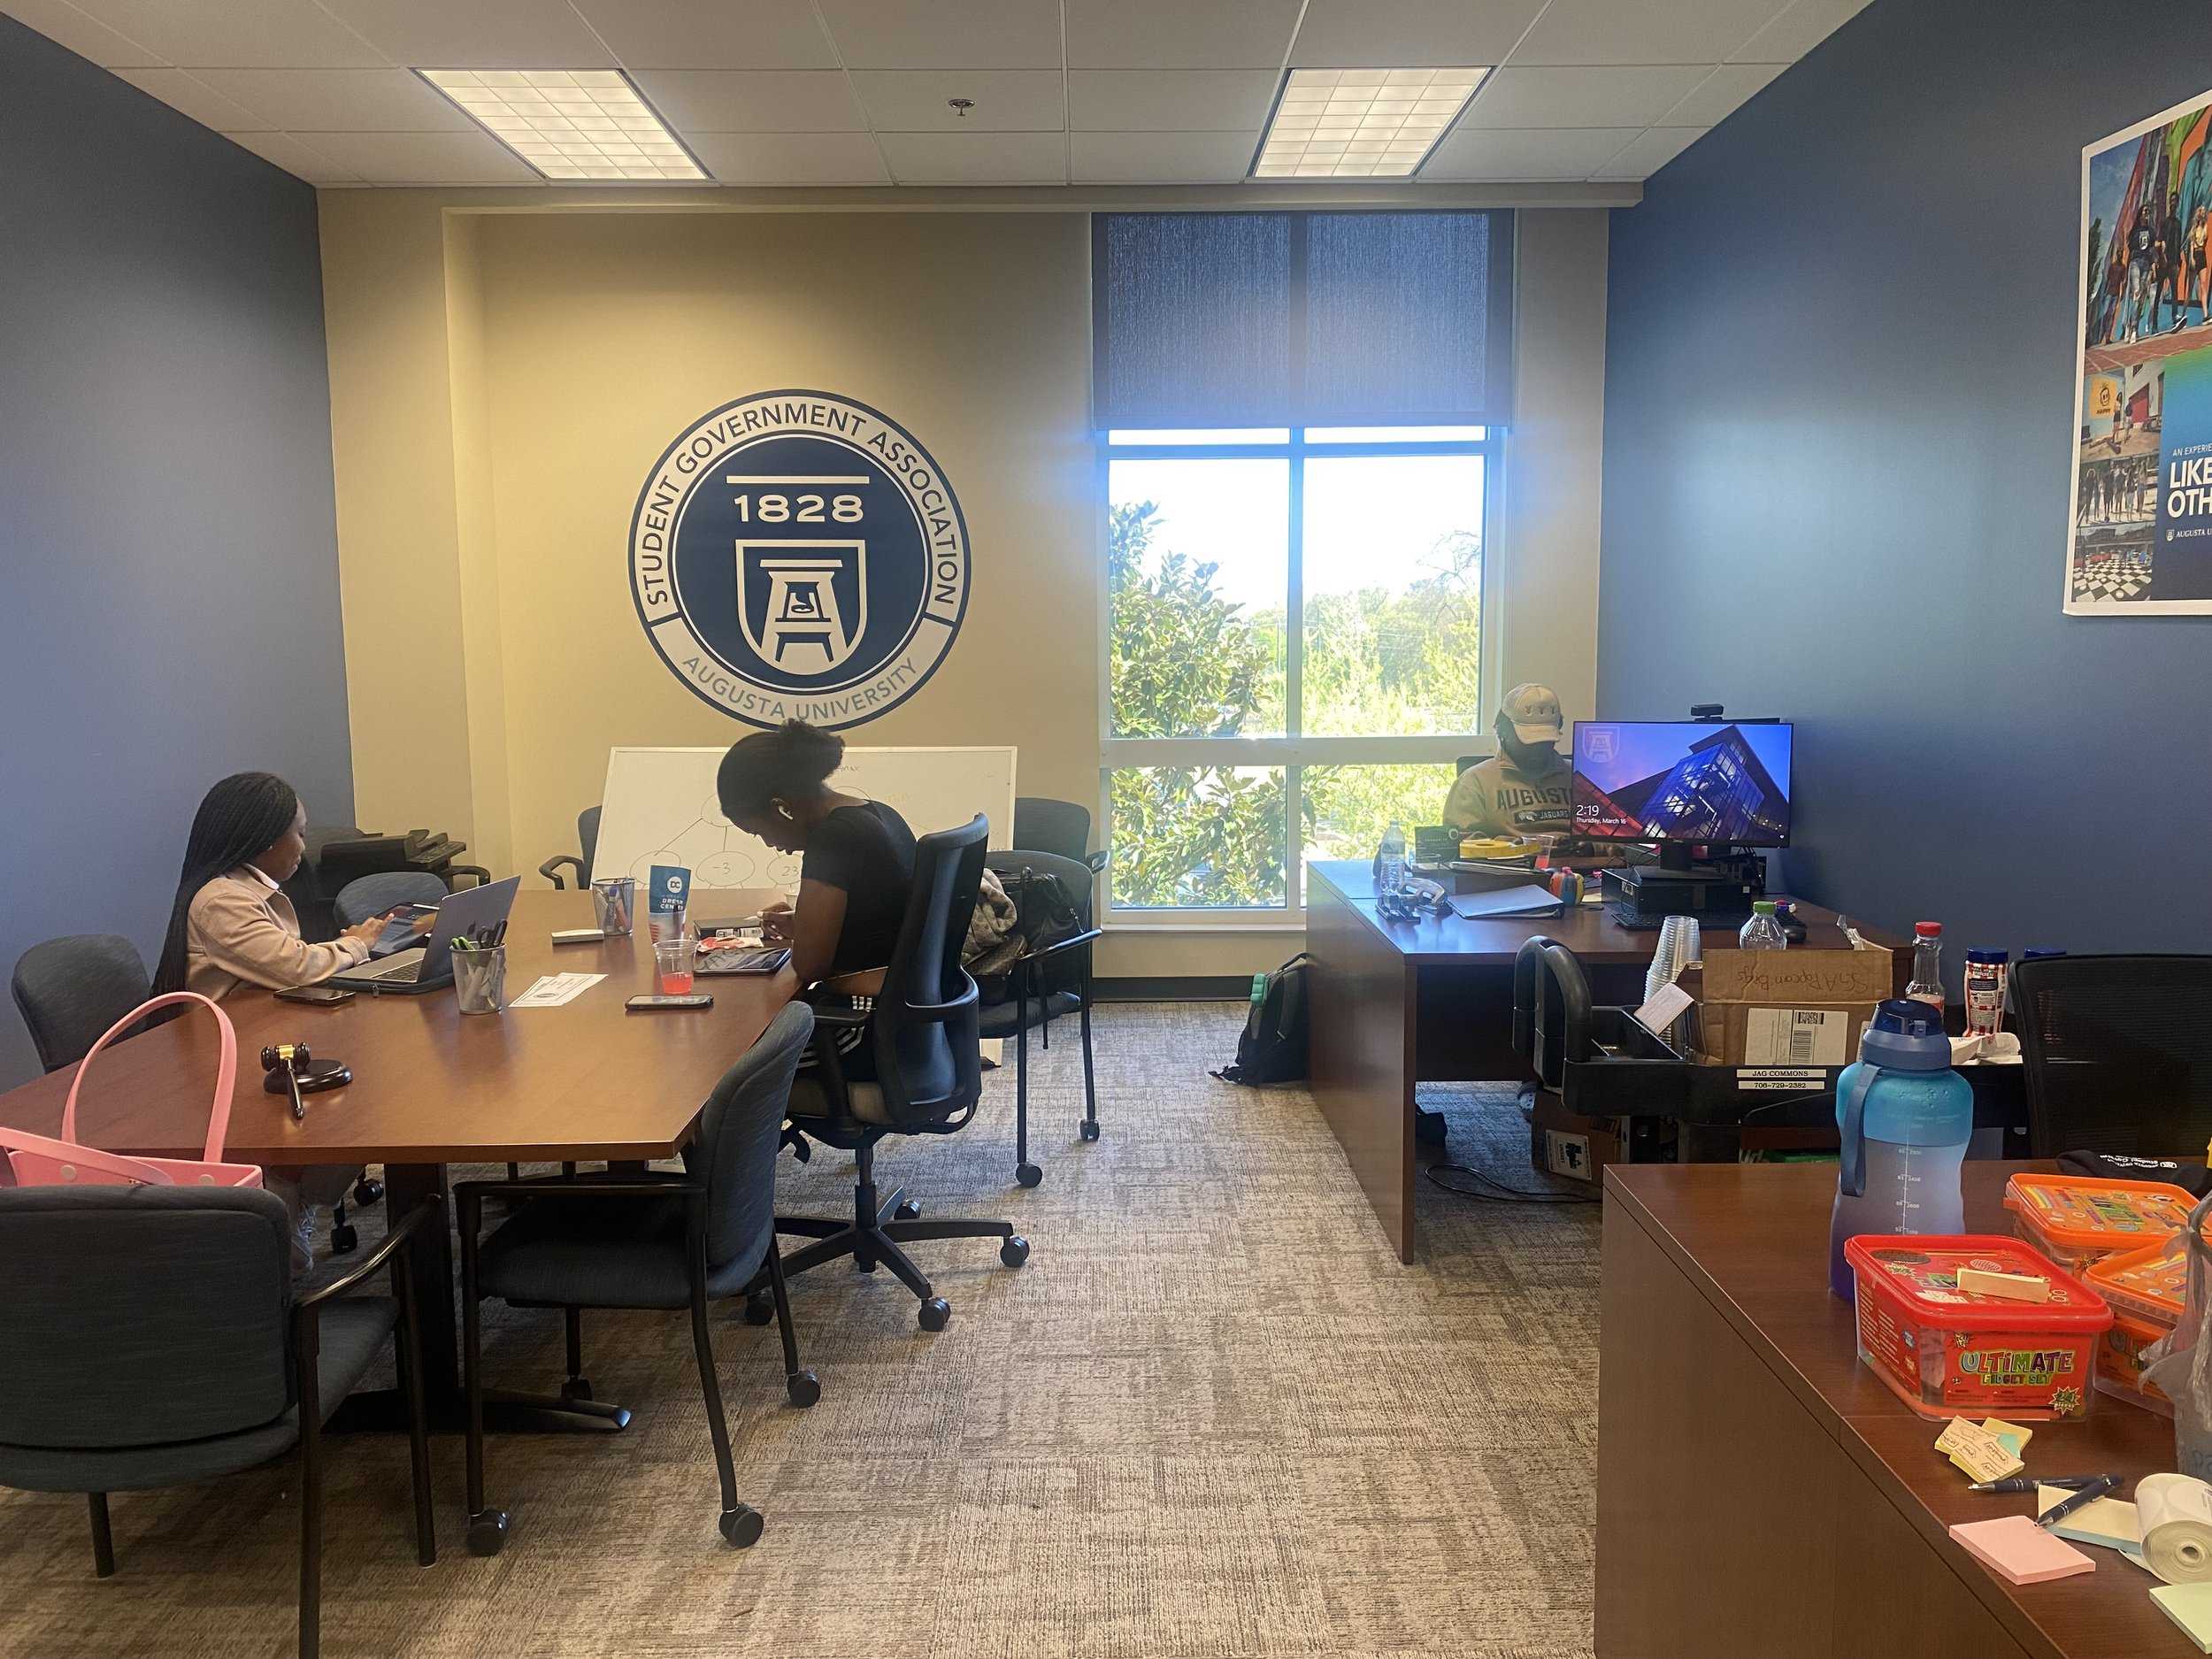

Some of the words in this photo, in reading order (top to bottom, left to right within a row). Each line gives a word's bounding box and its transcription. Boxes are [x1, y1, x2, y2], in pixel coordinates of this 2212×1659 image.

[2170, 457, 2212, 488] LIKE
[641, 475, 680, 605] STUDENT
[676, 403, 866, 473] GOVERNMENT
[868, 431, 958, 605] ASSOCIATION
[733, 494, 864, 523] 1828
[2168, 488, 2212, 518] OTH
[2177, 529, 2206, 538] AUGUSTA
[682, 656, 786, 719] AUGUSTA
[795, 657, 917, 721] UNIVERSITY
[1496, 787, 1571, 810] AUGUST
[1576, 804, 1600, 817] 2:19
[1982, 1374, 2025, 1385] FIDGET
[2028, 1374, 2051, 1385] SET
